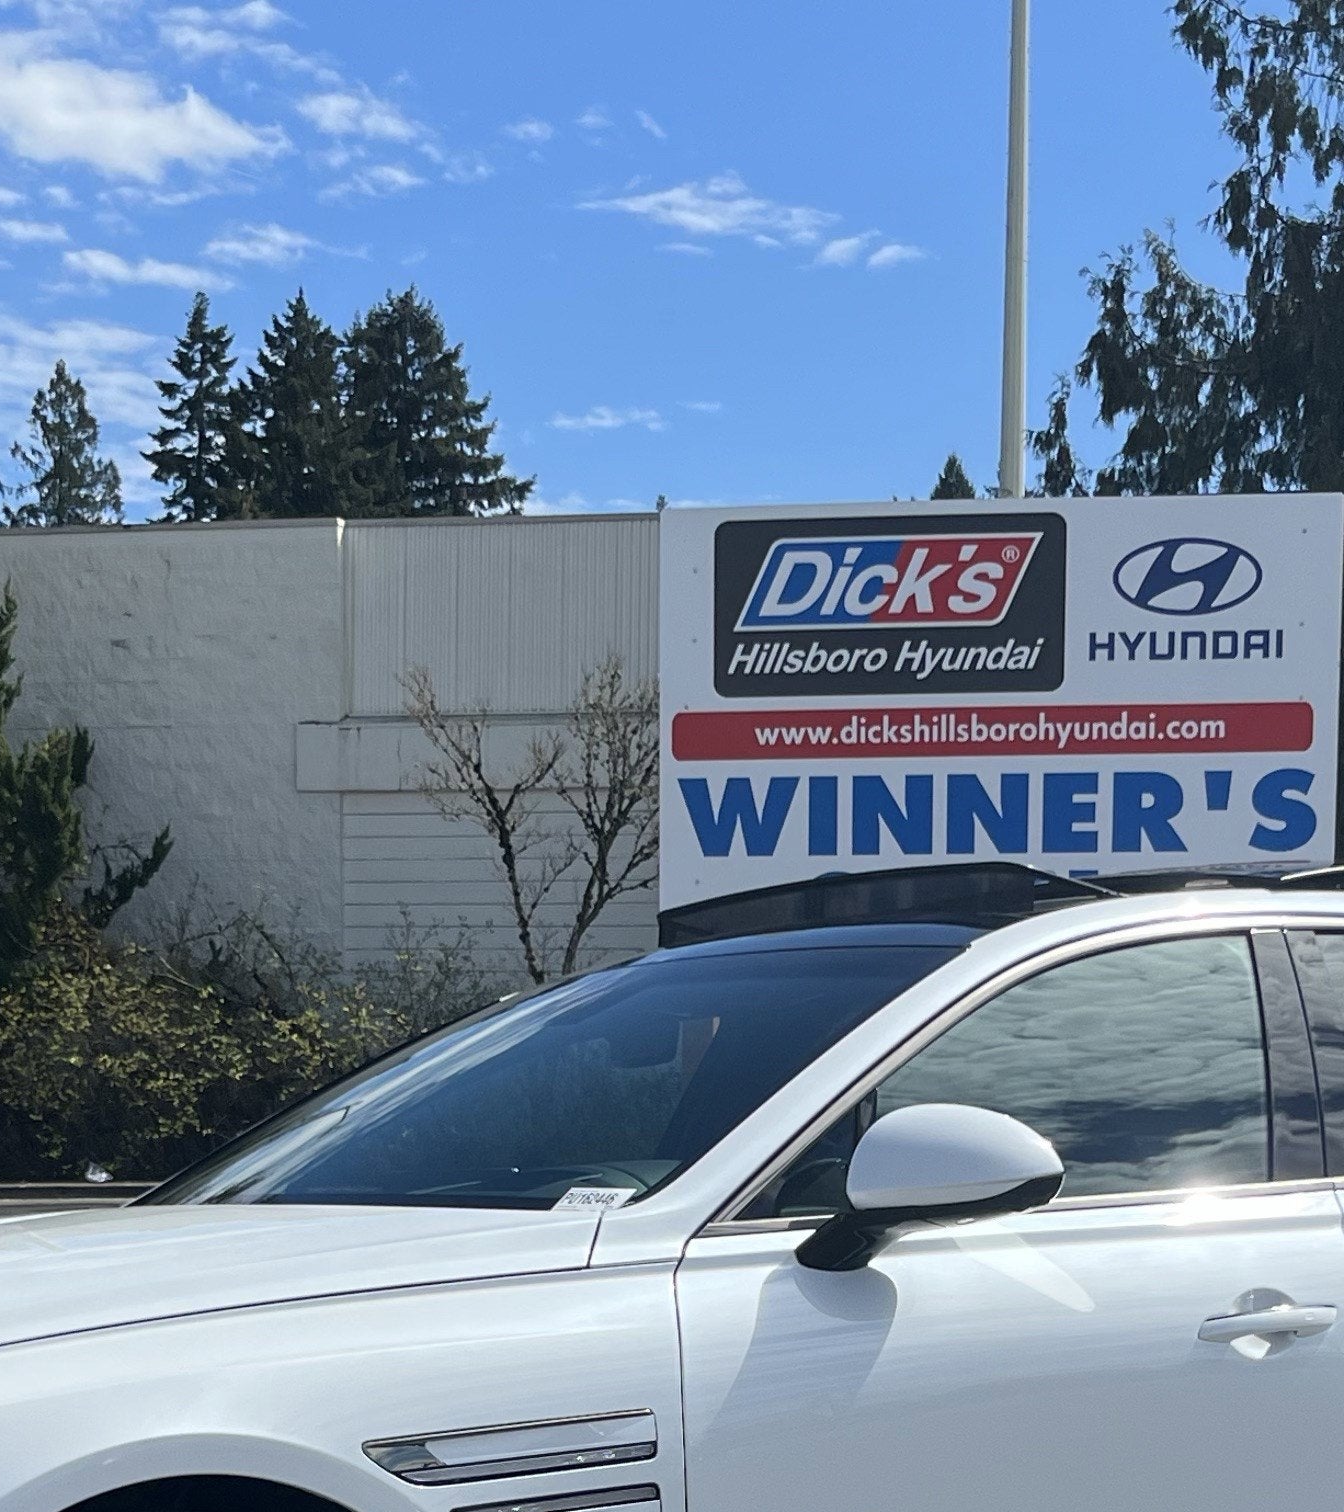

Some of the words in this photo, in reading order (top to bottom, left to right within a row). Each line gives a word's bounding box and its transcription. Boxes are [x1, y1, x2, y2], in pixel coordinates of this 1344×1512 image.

[757, 545, 1008, 618] Dick's
[728, 639, 887, 676] Hillsboro
[894, 638, 1044, 680] Hyundai
[1088, 628, 1283, 662] HYUNDAI
[754, 712, 1226, 749] www.dickshillsborohyundai.com
[677, 768, 1318, 857] WINNER'S
